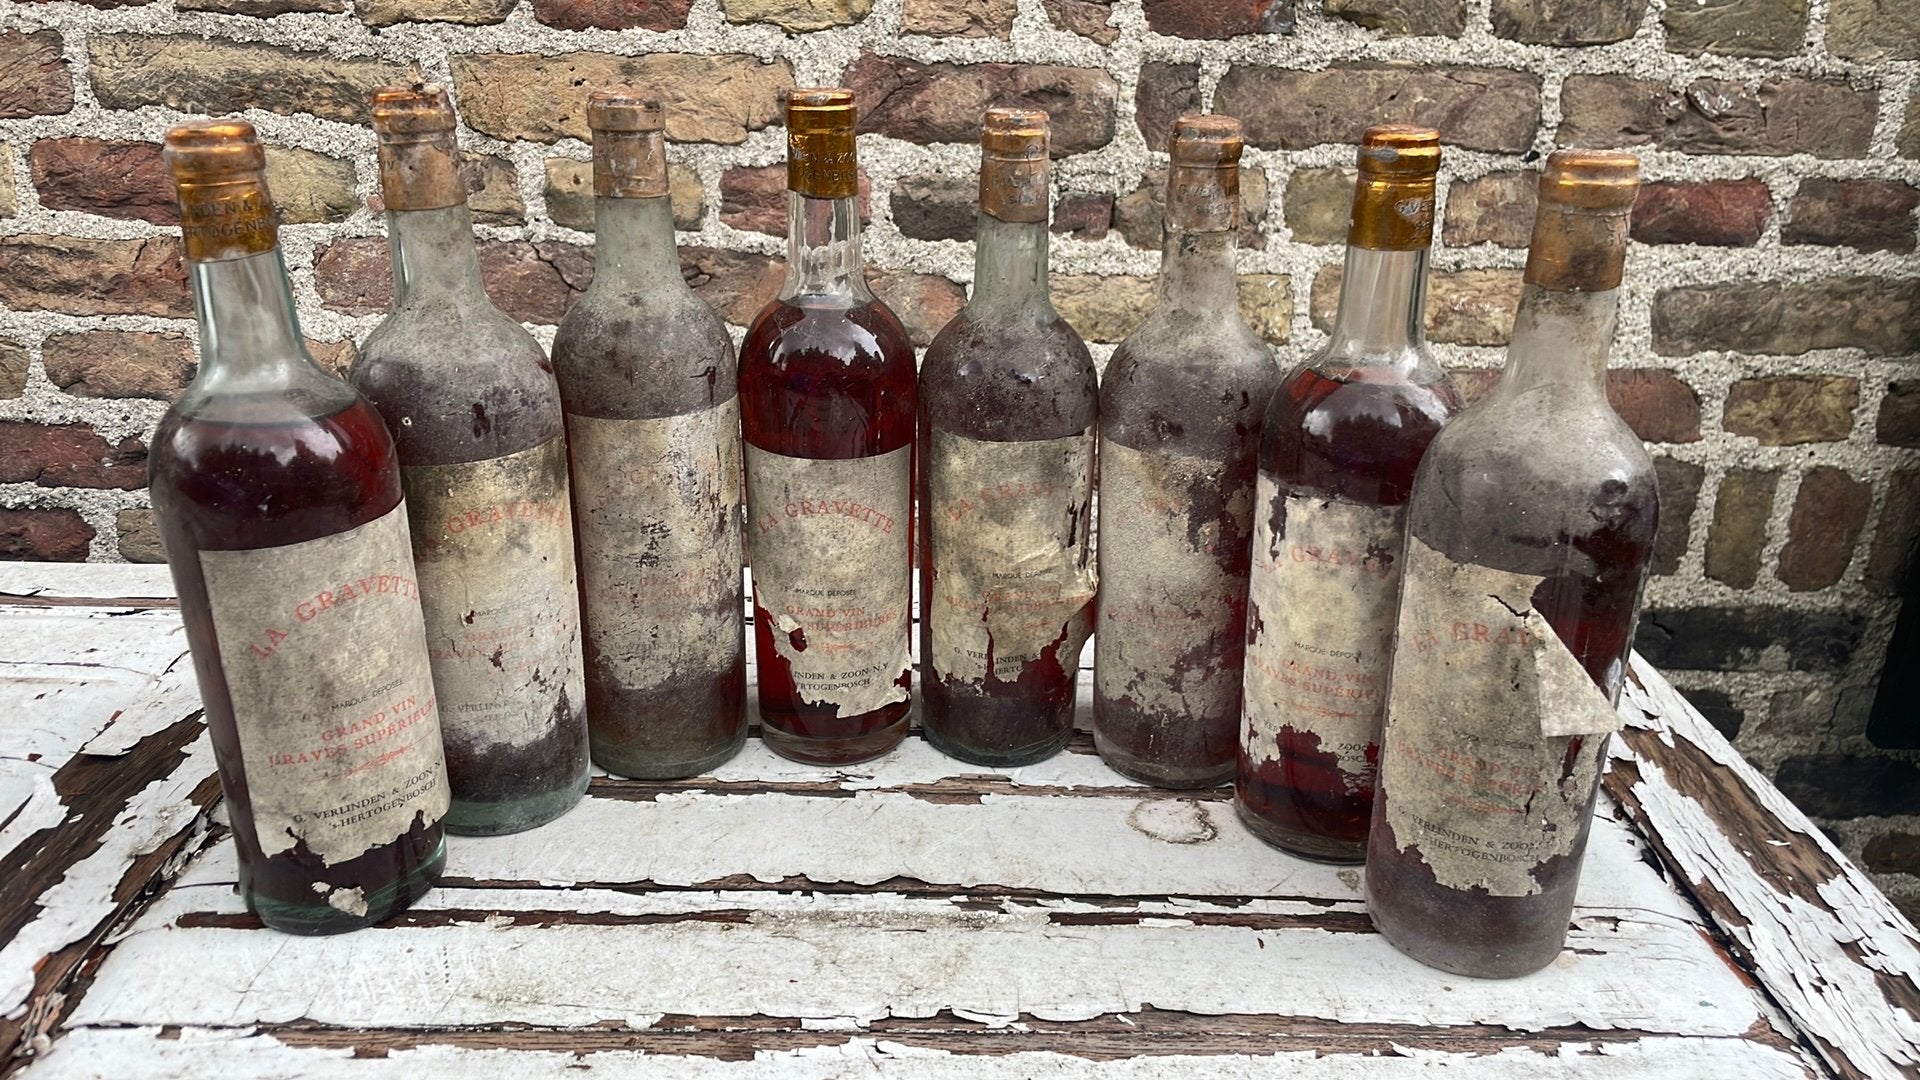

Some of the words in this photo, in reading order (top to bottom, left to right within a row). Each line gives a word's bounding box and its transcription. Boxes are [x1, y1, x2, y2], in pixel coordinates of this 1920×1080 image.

[758, 512, 780, 535] LA
[784, 500, 896, 535] GRAVETTE
[944, 498, 973, 521] LA
[786, 604, 837, 618] GRAND
[842, 606, 866, 618] VIN
[249, 627, 288, 658] LA
[841, 667, 870, 679] ZOON
[1281, 657, 1338, 682] GRAND
[321, 711, 386, 742] GRAND
[392, 695, 418, 716] VIN
[313, 791, 387, 820] VERLINDEN
[391, 786, 400, 796] &
[403, 766, 434, 789] ZOON
[1485, 841, 1495, 849] &
